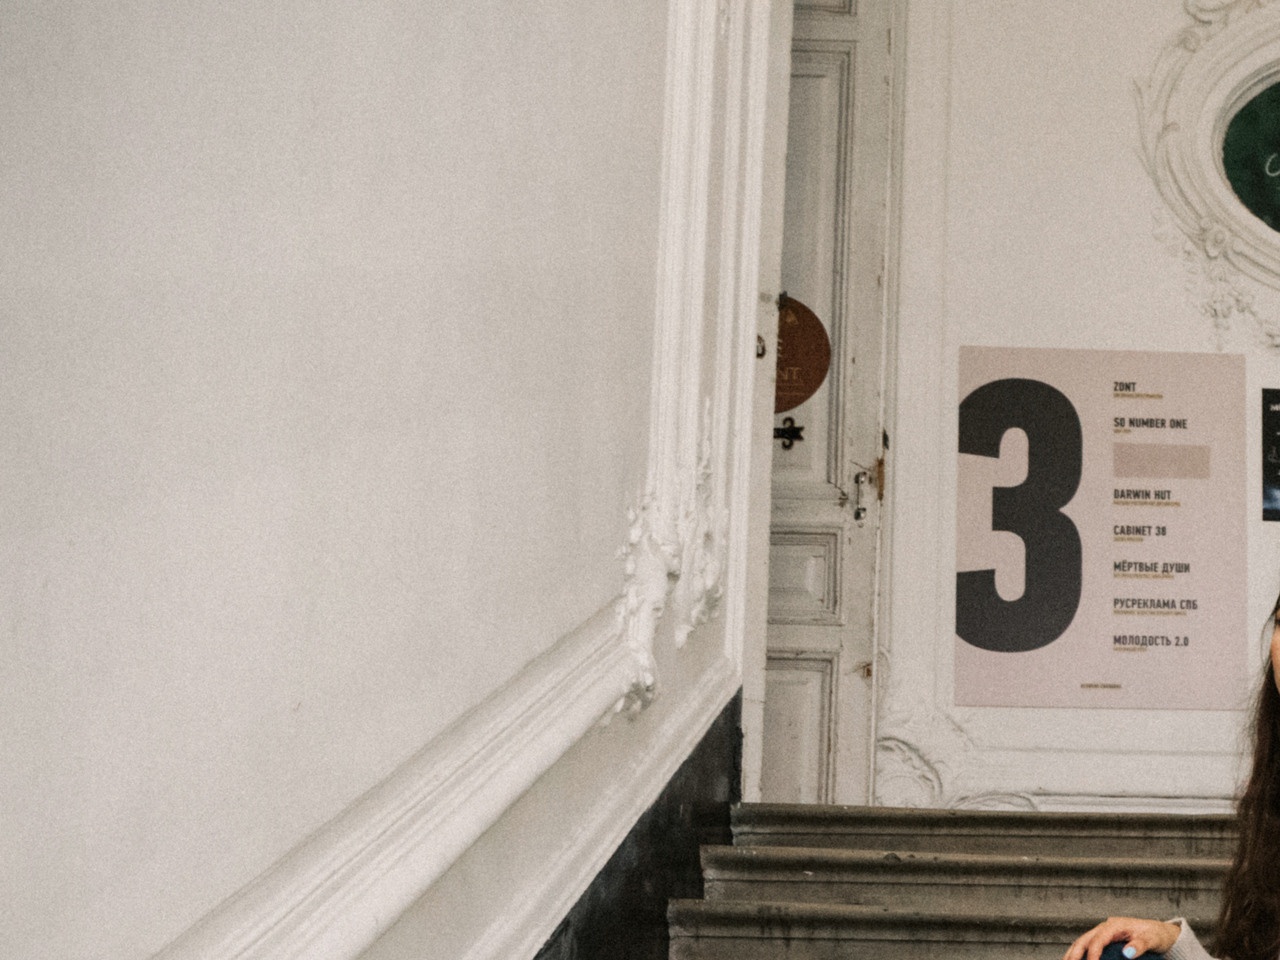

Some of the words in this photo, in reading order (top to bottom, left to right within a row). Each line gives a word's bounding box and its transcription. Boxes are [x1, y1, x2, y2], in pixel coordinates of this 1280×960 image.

[1113, 381, 1136, 392] ZONT
[1113, 417, 1126, 428] SO
[1128, 418, 1167, 429] NUMBER
[1169, 418, 1188, 429] ONE
[1113, 489, 1151, 500] DARWIN
[1154, 490, 1171, 501] HUT
[955, 377, 1083, 653] 3
[1113, 524, 1152, 536] CABINET
[1113, 560, 1159, 573] МЁРТВЫЕ
[1161, 562, 1190, 574] ДУШИ
[1113, 598, 1177, 610] РУСРЕКЛАМА
[1179, 600, 1198, 610] СПБ
[1113, 635, 1172, 647] МОЛОДОСТЬ
[1174, 636, 1190, 647] 2.0
